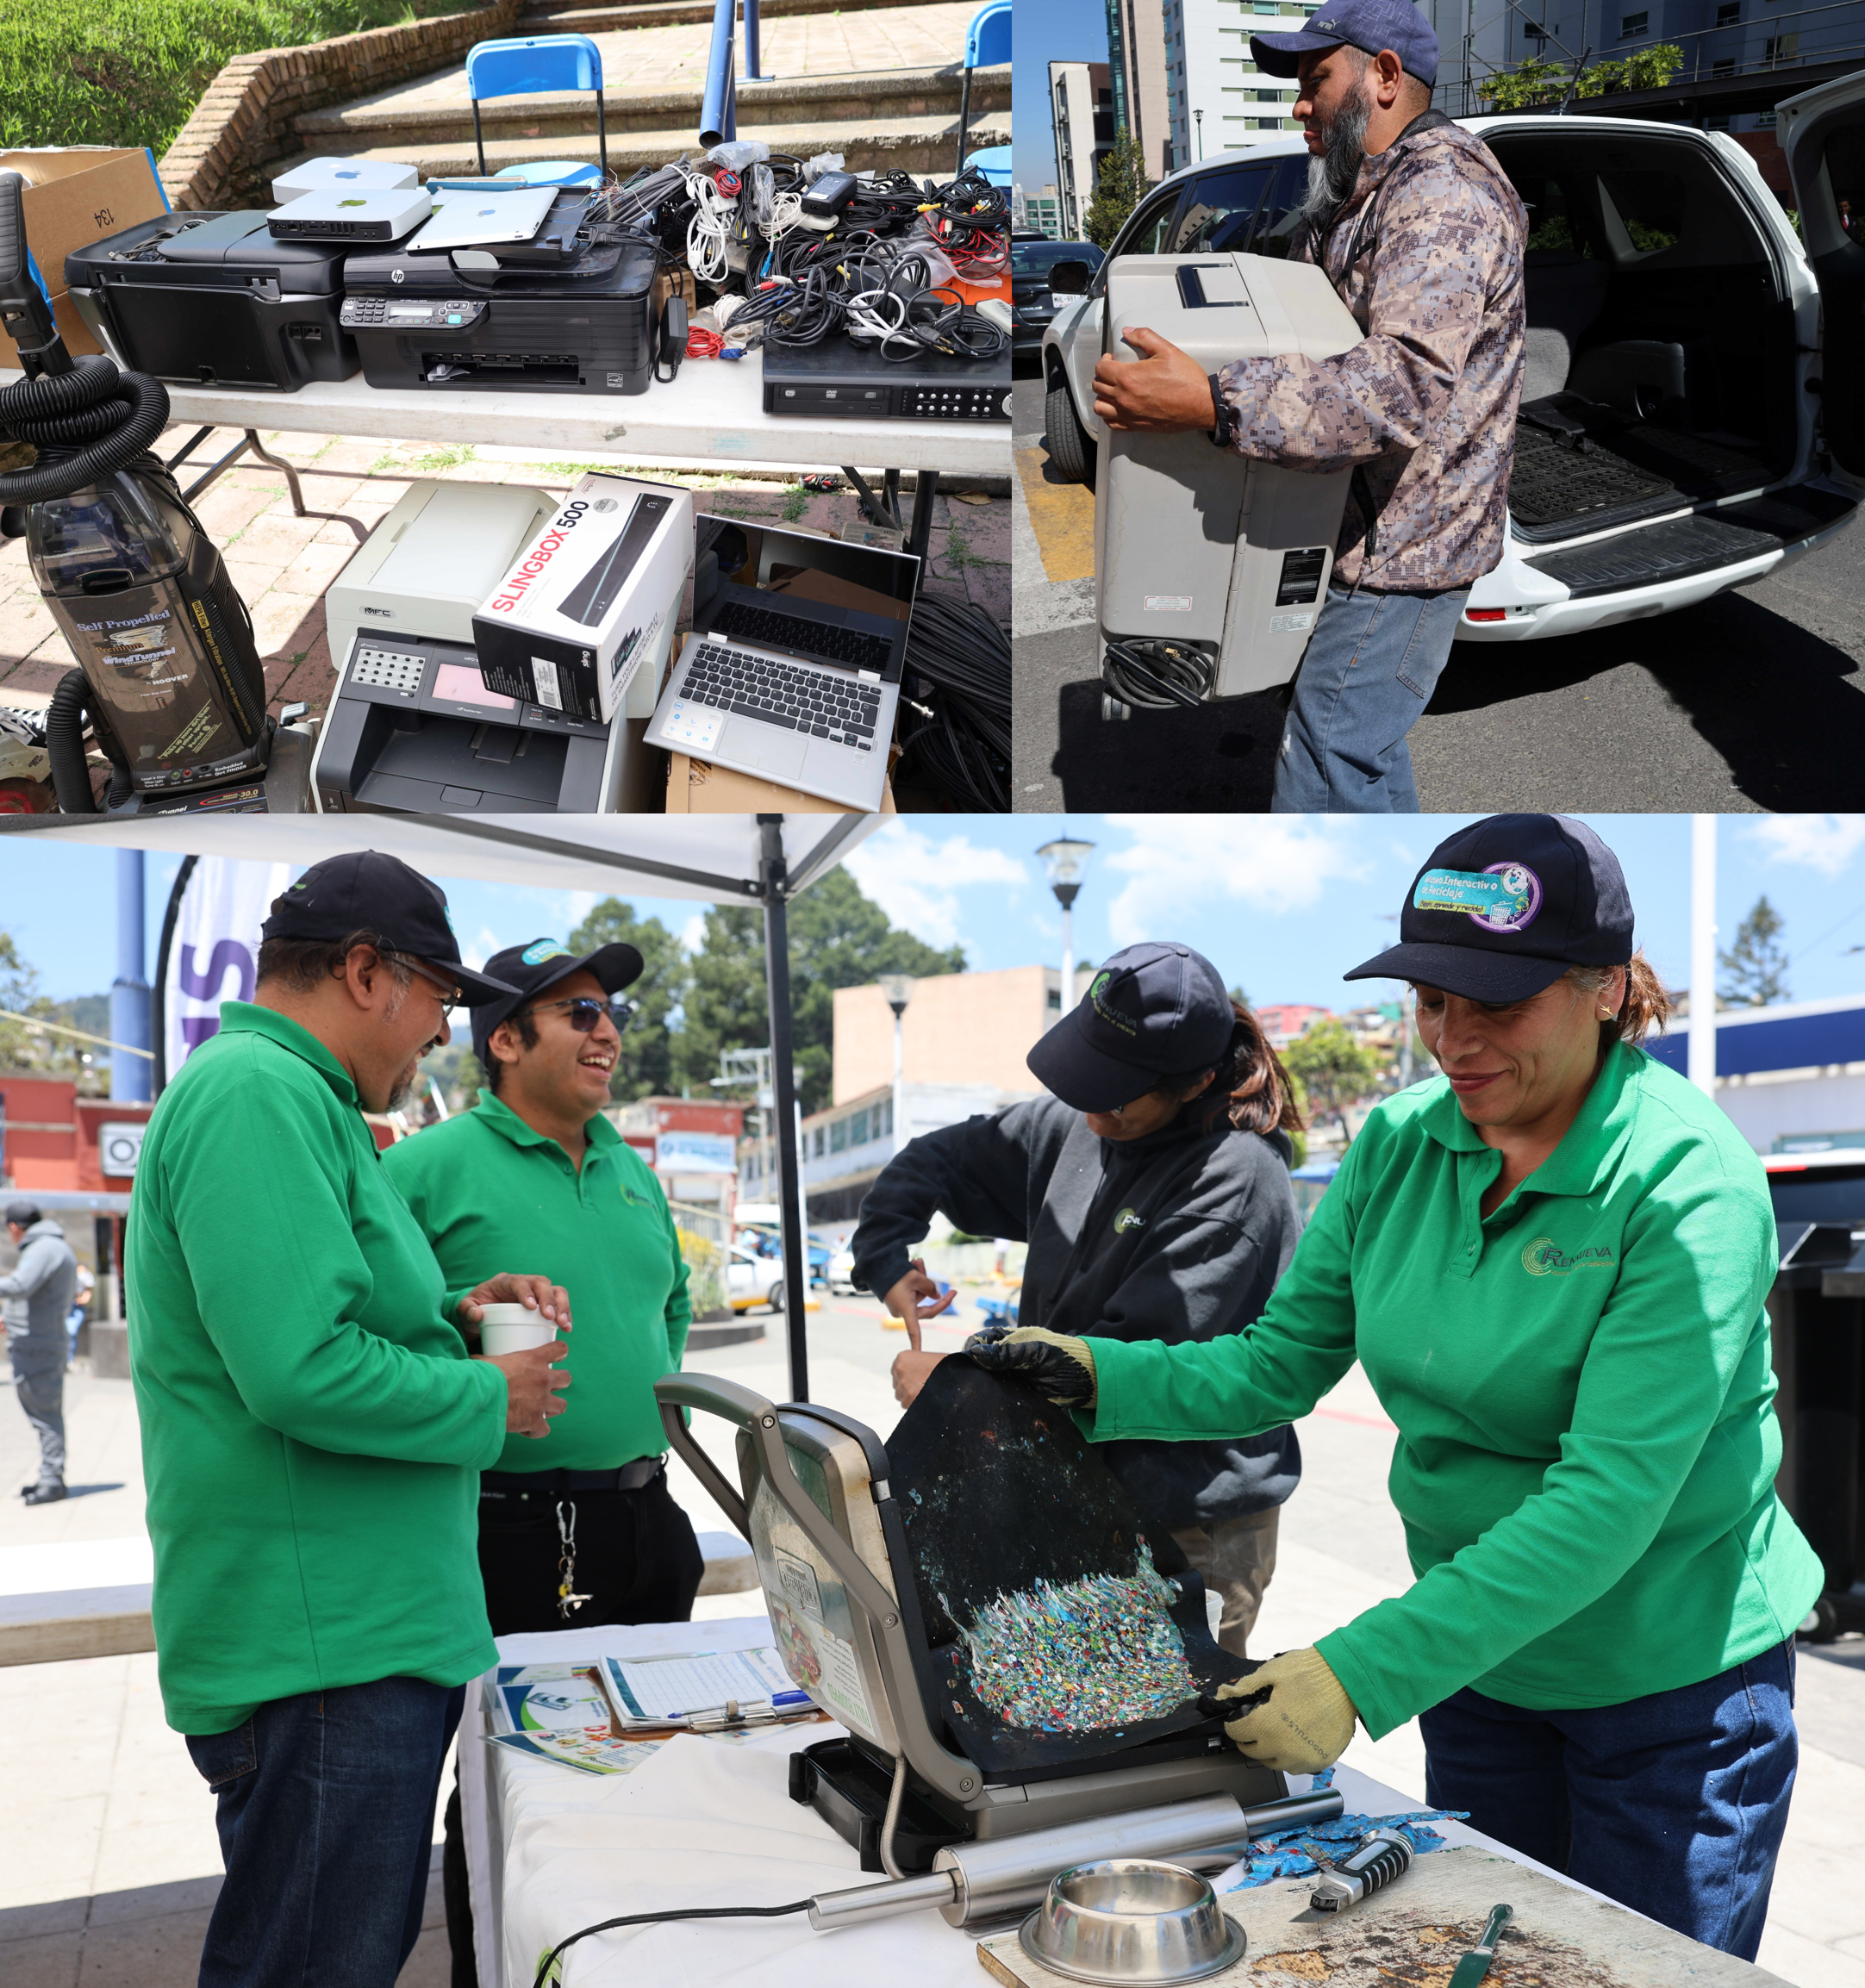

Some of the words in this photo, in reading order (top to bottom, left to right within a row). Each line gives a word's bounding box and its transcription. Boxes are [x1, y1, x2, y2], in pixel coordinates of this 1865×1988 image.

[1318, 21, 1332, 31] PUMA
[94, 208, 114, 228] 134
[392, 269, 404, 283] hp
[492, 528, 570, 612] SLINGBOX
[556, 501, 589, 528] 500
[77, 621, 103, 632] Self
[105, 609, 171, 629] Propelled
[365, 608, 390, 617] MFC
[96, 643, 145, 654] Premium
[202, 627, 217, 647] Allergen
[210, 645, 225, 666] Filtration
[103, 647, 176, 665] WindTunnel
[124, 657, 159, 666] TECHNOLOGY
[581, 650, 590, 667] sling
[611, 678, 622, 699] TURN
[621, 663, 633, 681] YOUR
[646, 612, 658, 636] TABLET
[152, 674, 188, 686] HOOVER
[163, 745, 177, 757] Picks
[180, 726, 193, 739] more
[190, 718, 201, 727] dirt
[198, 706, 210, 719] than
[174, 745, 184, 755] any
[181, 732, 195, 746] other
[187, 732, 205, 749] Period
[215, 761, 244, 772] Embedded
[227, 764, 247, 775] FINDER
[1421, 885, 1428, 894] de
[1429, 887, 1464, 900] Reciclaje
